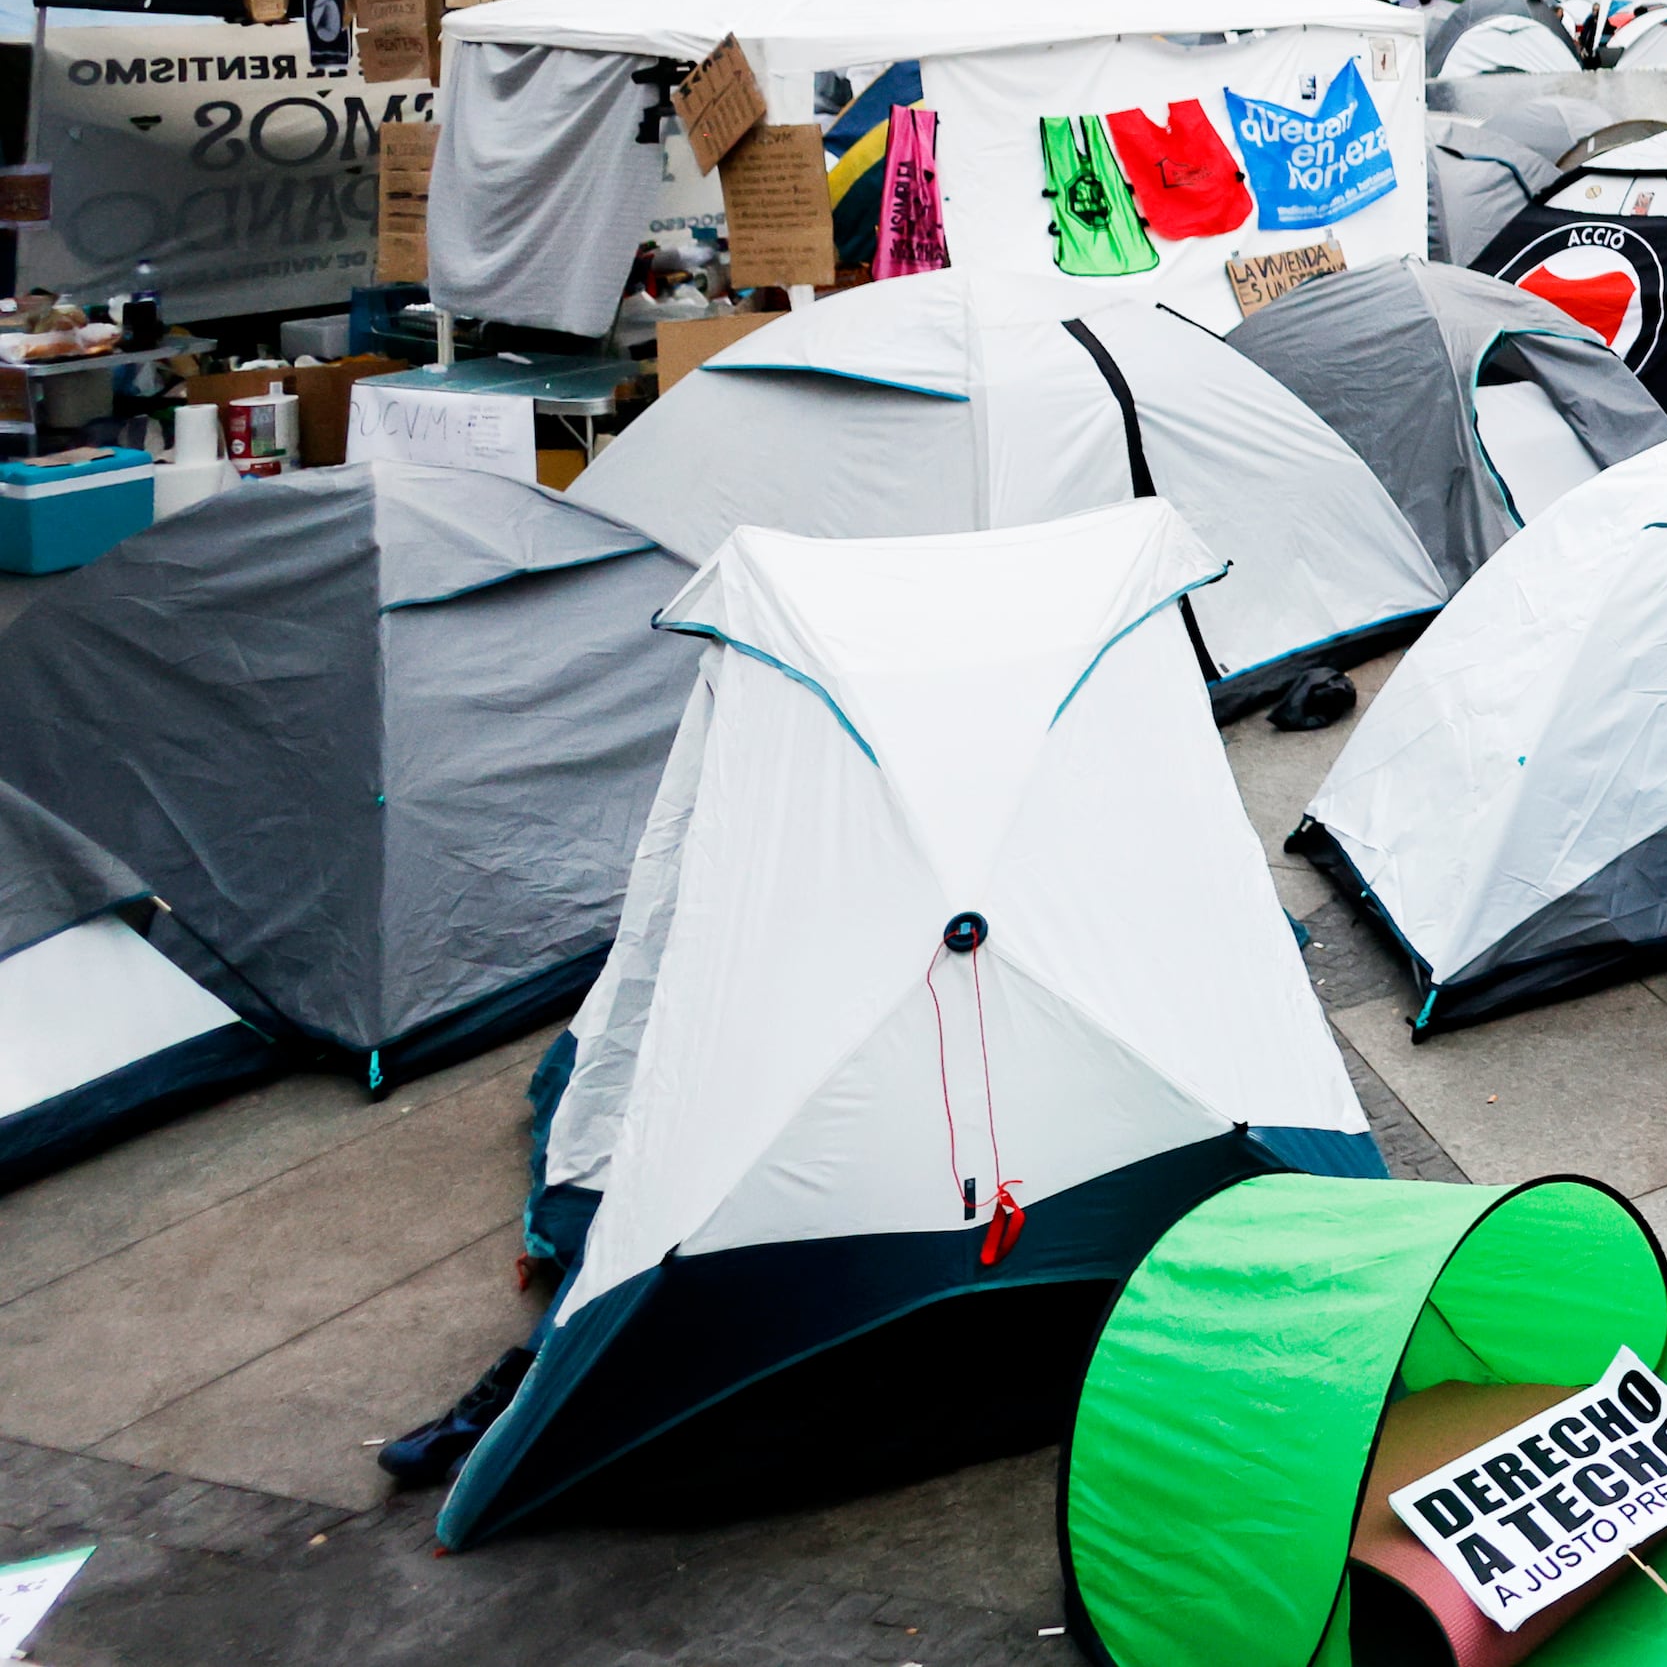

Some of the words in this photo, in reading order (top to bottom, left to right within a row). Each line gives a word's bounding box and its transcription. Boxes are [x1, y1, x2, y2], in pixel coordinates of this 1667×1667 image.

[1291, 143, 1336, 167] en
[1567, 226, 1626, 249] ACCIÓ
[1232, 260, 1256, 283] LA
[1253, 243, 1330, 280] VIVIENDA
[1412, 1369, 1662, 1540] DERECHO
[1456, 1532, 1516, 1586] A
[1494, 1584, 1523, 1608] A
[1523, 1518, 1619, 1593] JUSTO
